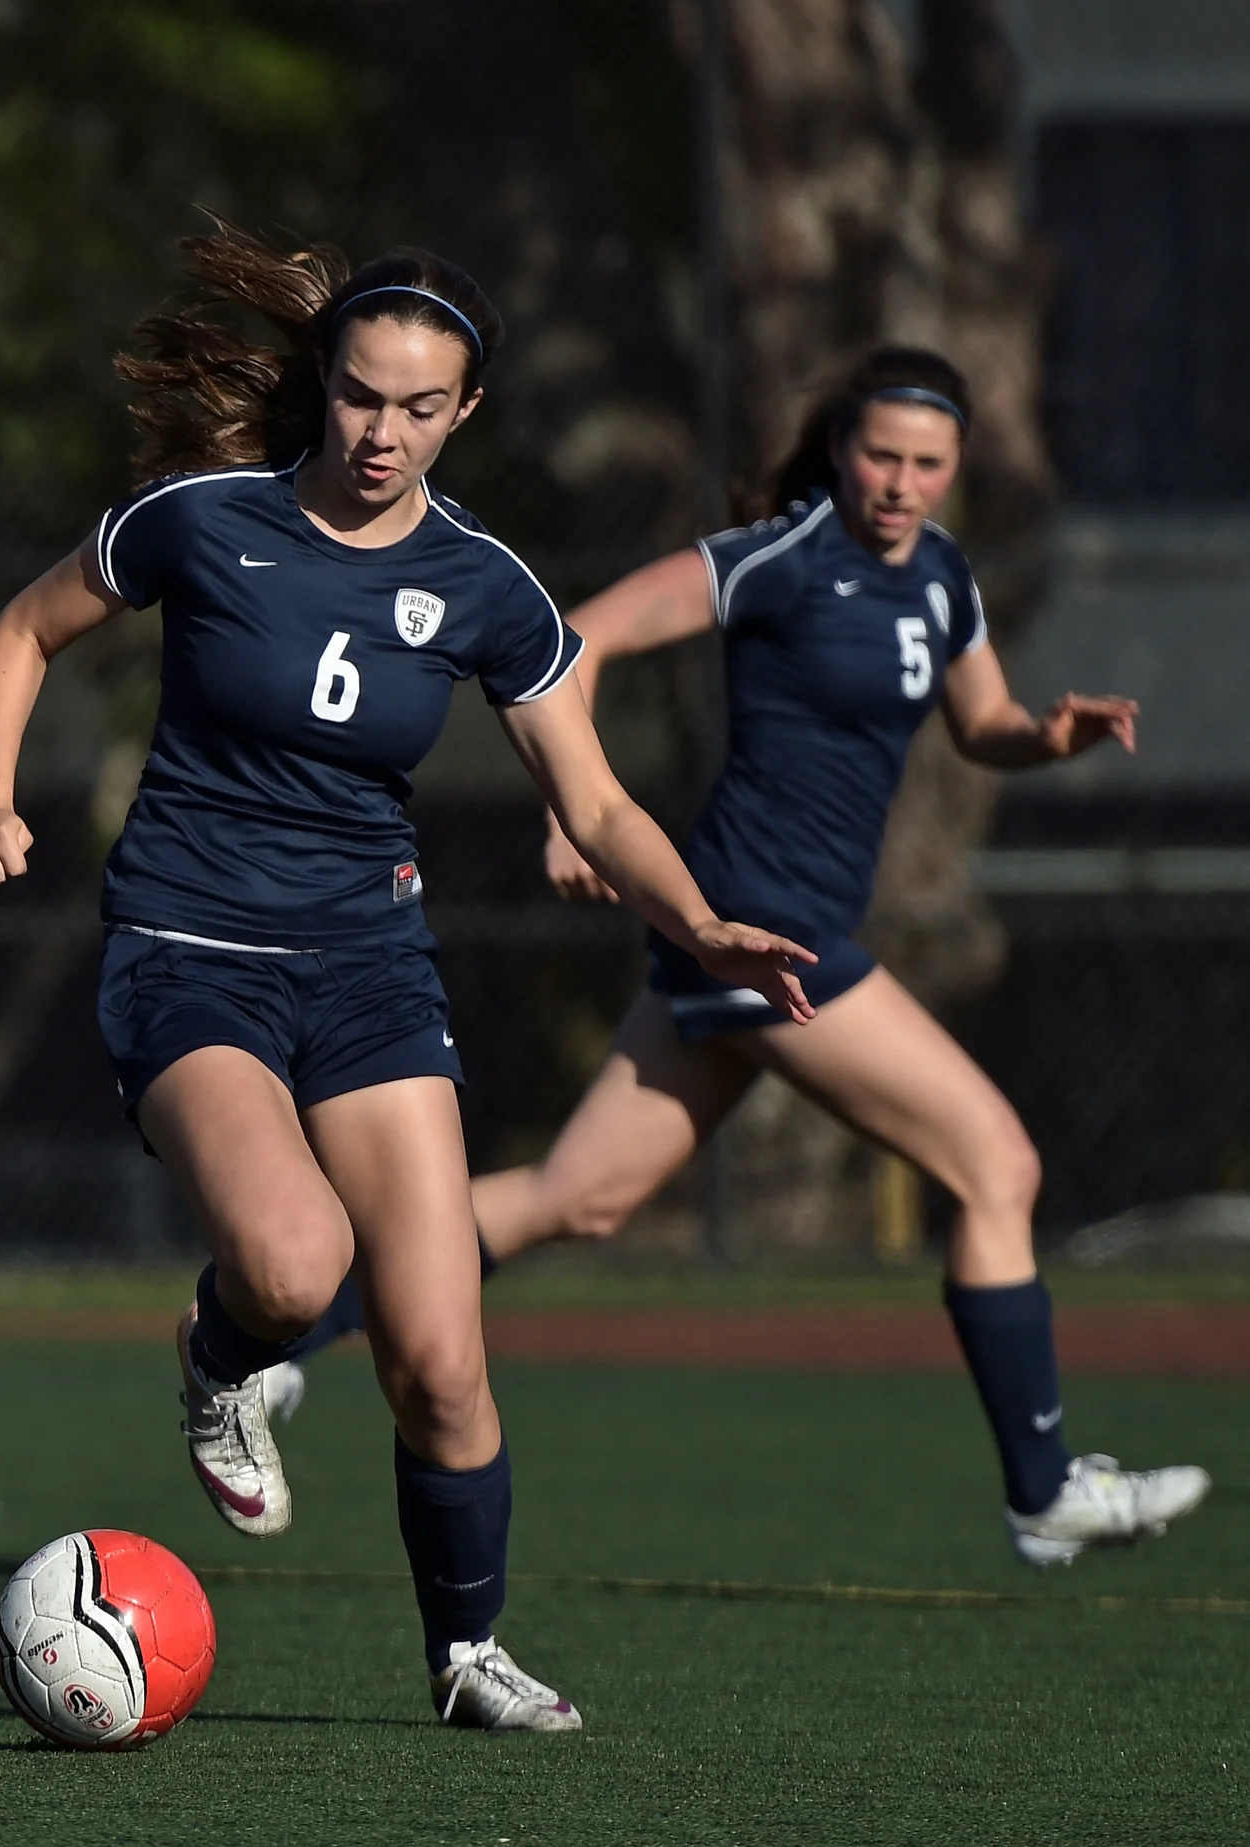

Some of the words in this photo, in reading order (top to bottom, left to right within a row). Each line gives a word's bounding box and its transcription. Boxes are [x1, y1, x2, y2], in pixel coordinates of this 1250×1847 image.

[402, 594, 438, 615] URBAN
[310, 630, 360, 723] 6
[895, 617, 933, 700] 5
[27, 1630, 64, 1657] senda
